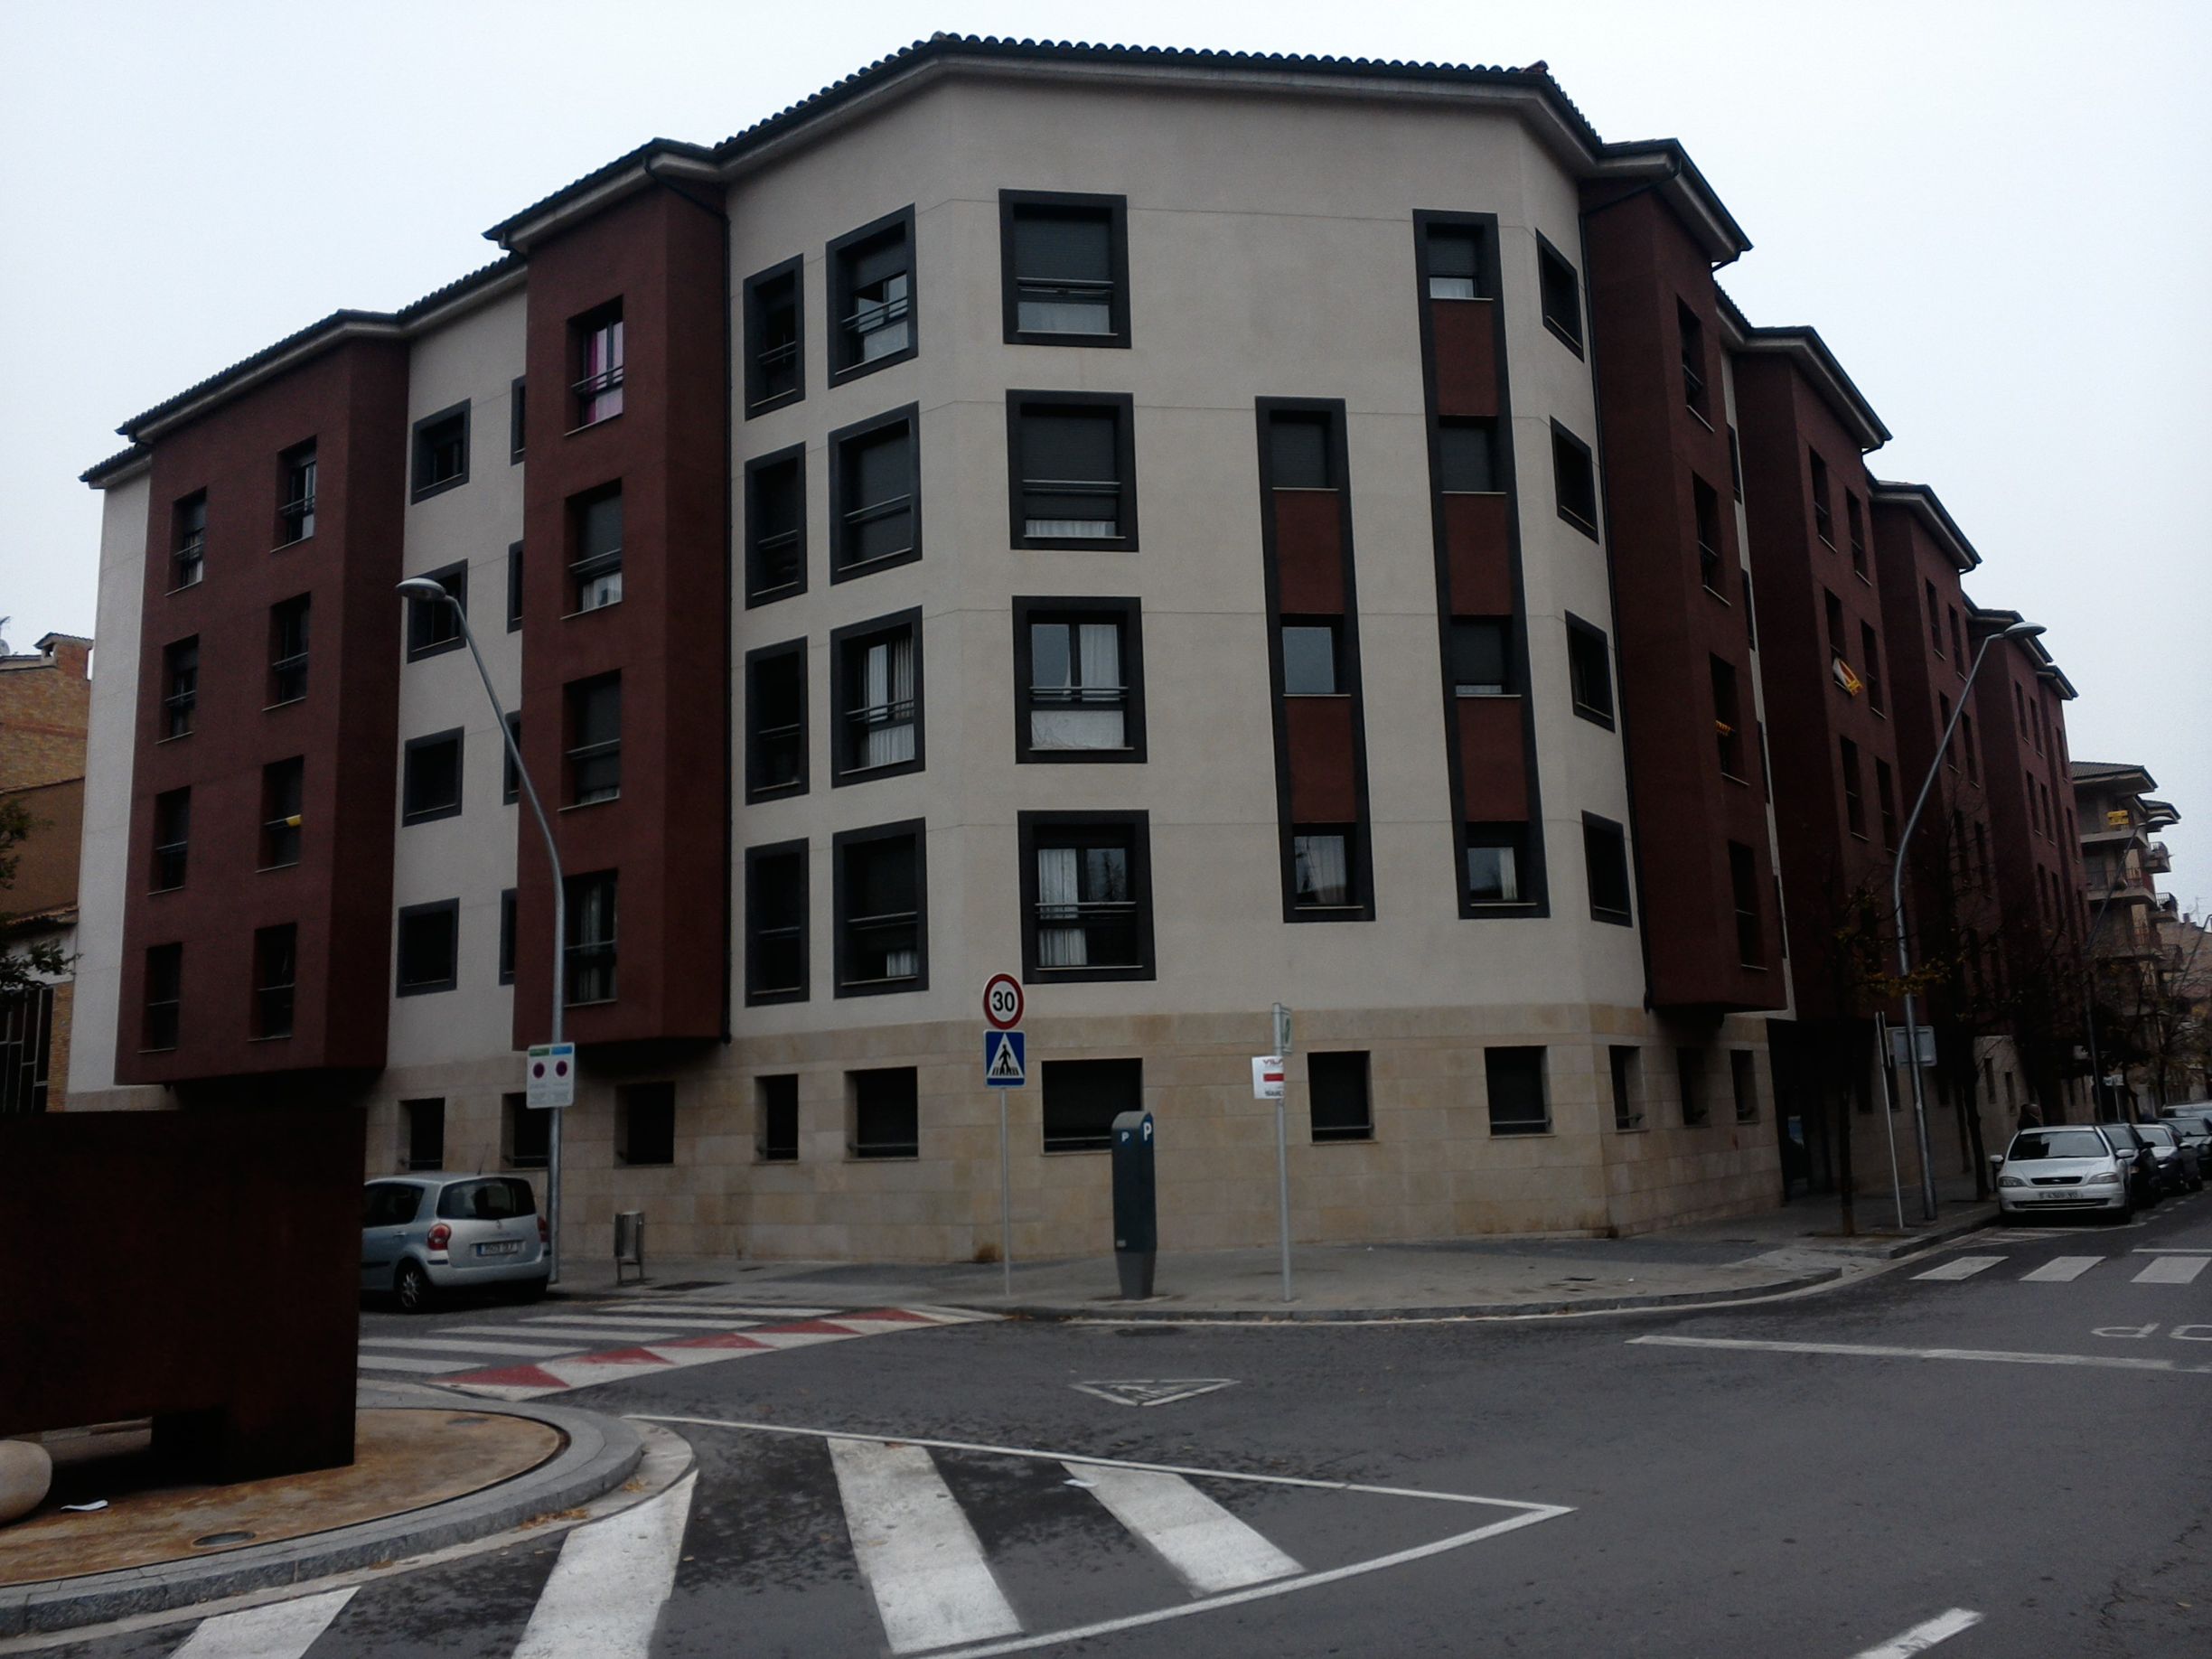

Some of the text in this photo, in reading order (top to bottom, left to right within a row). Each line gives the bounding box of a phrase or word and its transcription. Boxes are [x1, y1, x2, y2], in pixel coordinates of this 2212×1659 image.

[992, 991, 1015, 1012] 30
[1121, 1131, 1129, 1142] P
[1143, 1121, 1152, 1141] P
